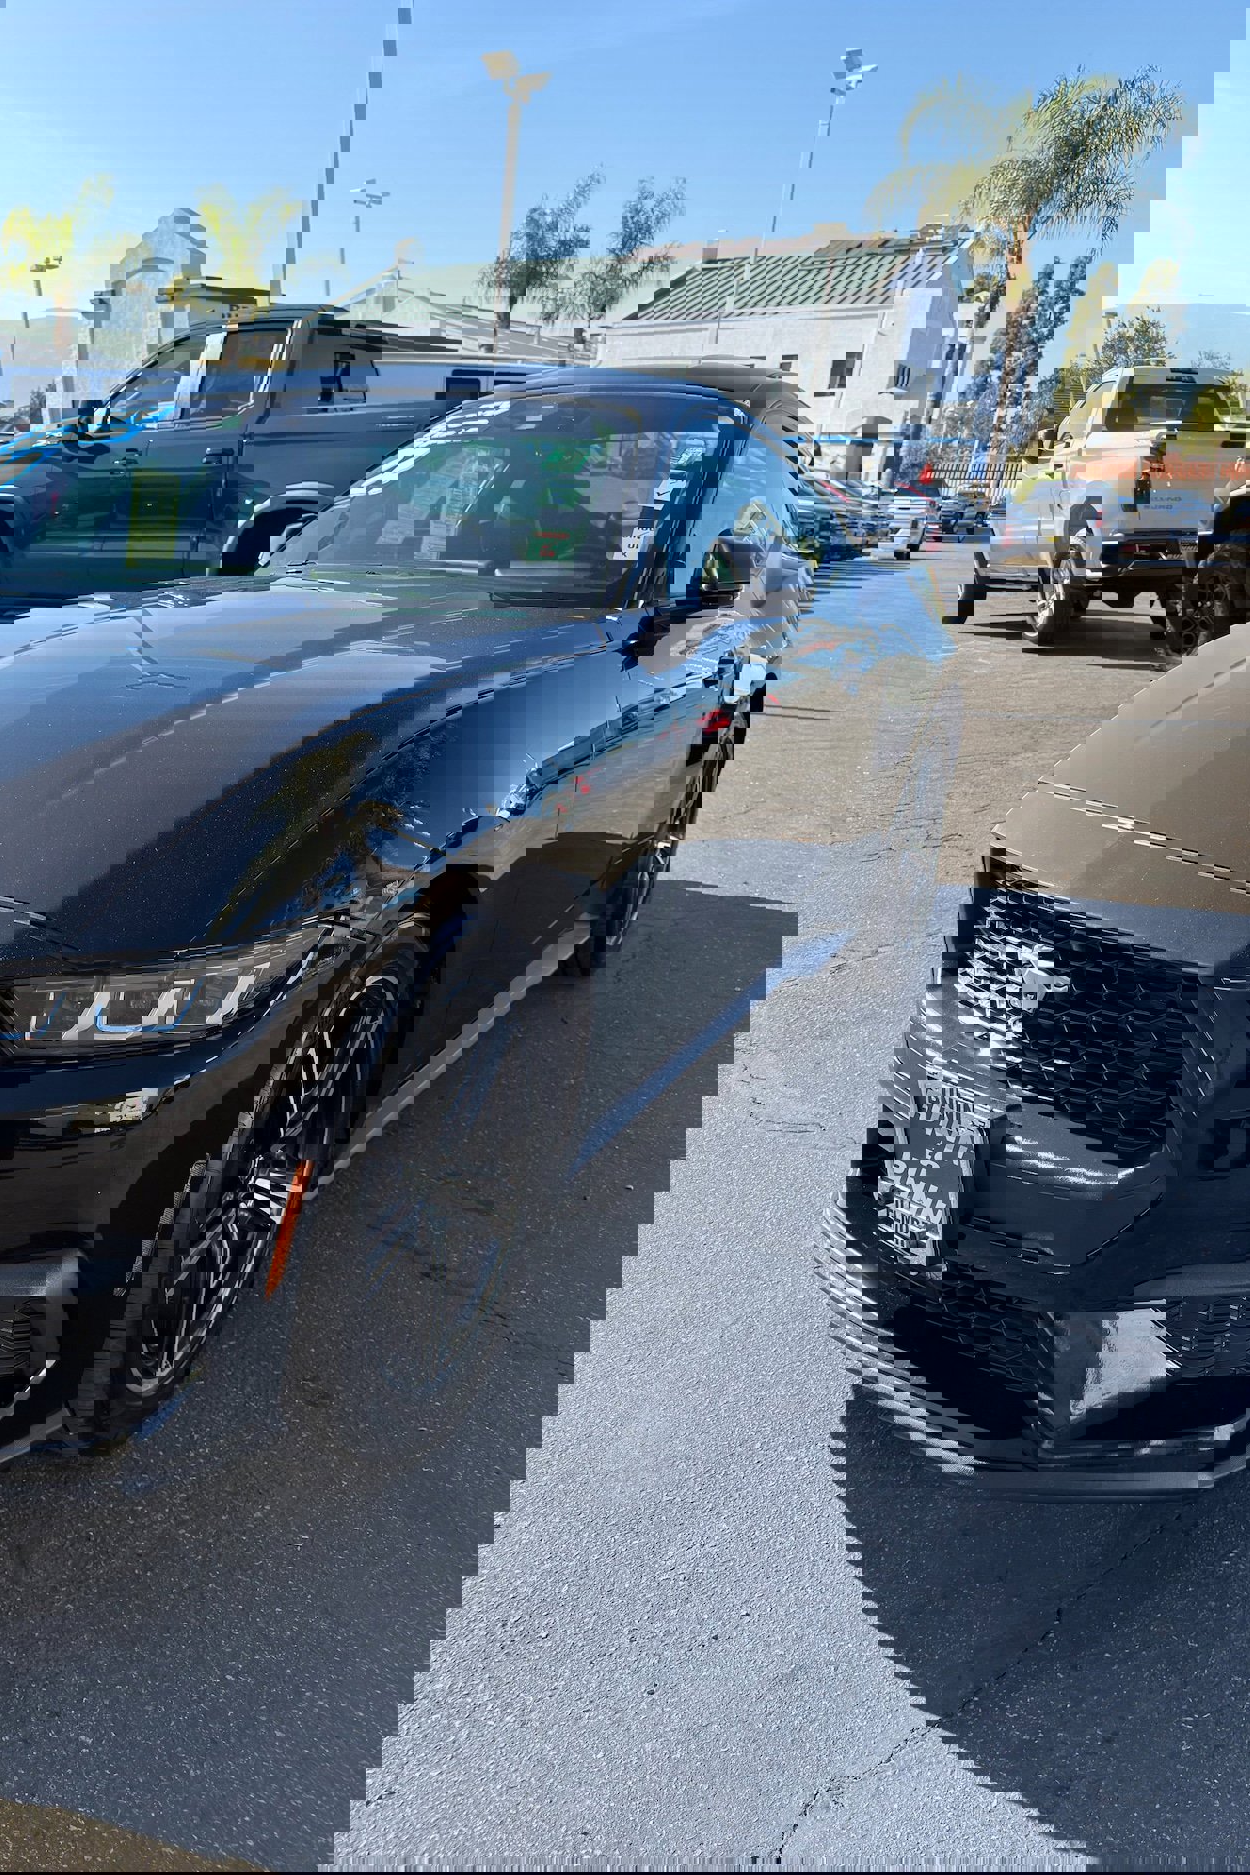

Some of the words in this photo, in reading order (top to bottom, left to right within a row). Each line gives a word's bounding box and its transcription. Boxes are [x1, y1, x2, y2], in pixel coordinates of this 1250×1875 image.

[32, 408, 166, 435] SPORTY
[7, 427, 130, 451] SHARP
[548, 481, 584, 490] SAFETY
[548, 497, 565, 505] OK
[533, 531, 569, 540] SMOG
[539, 549, 556, 557] OK
